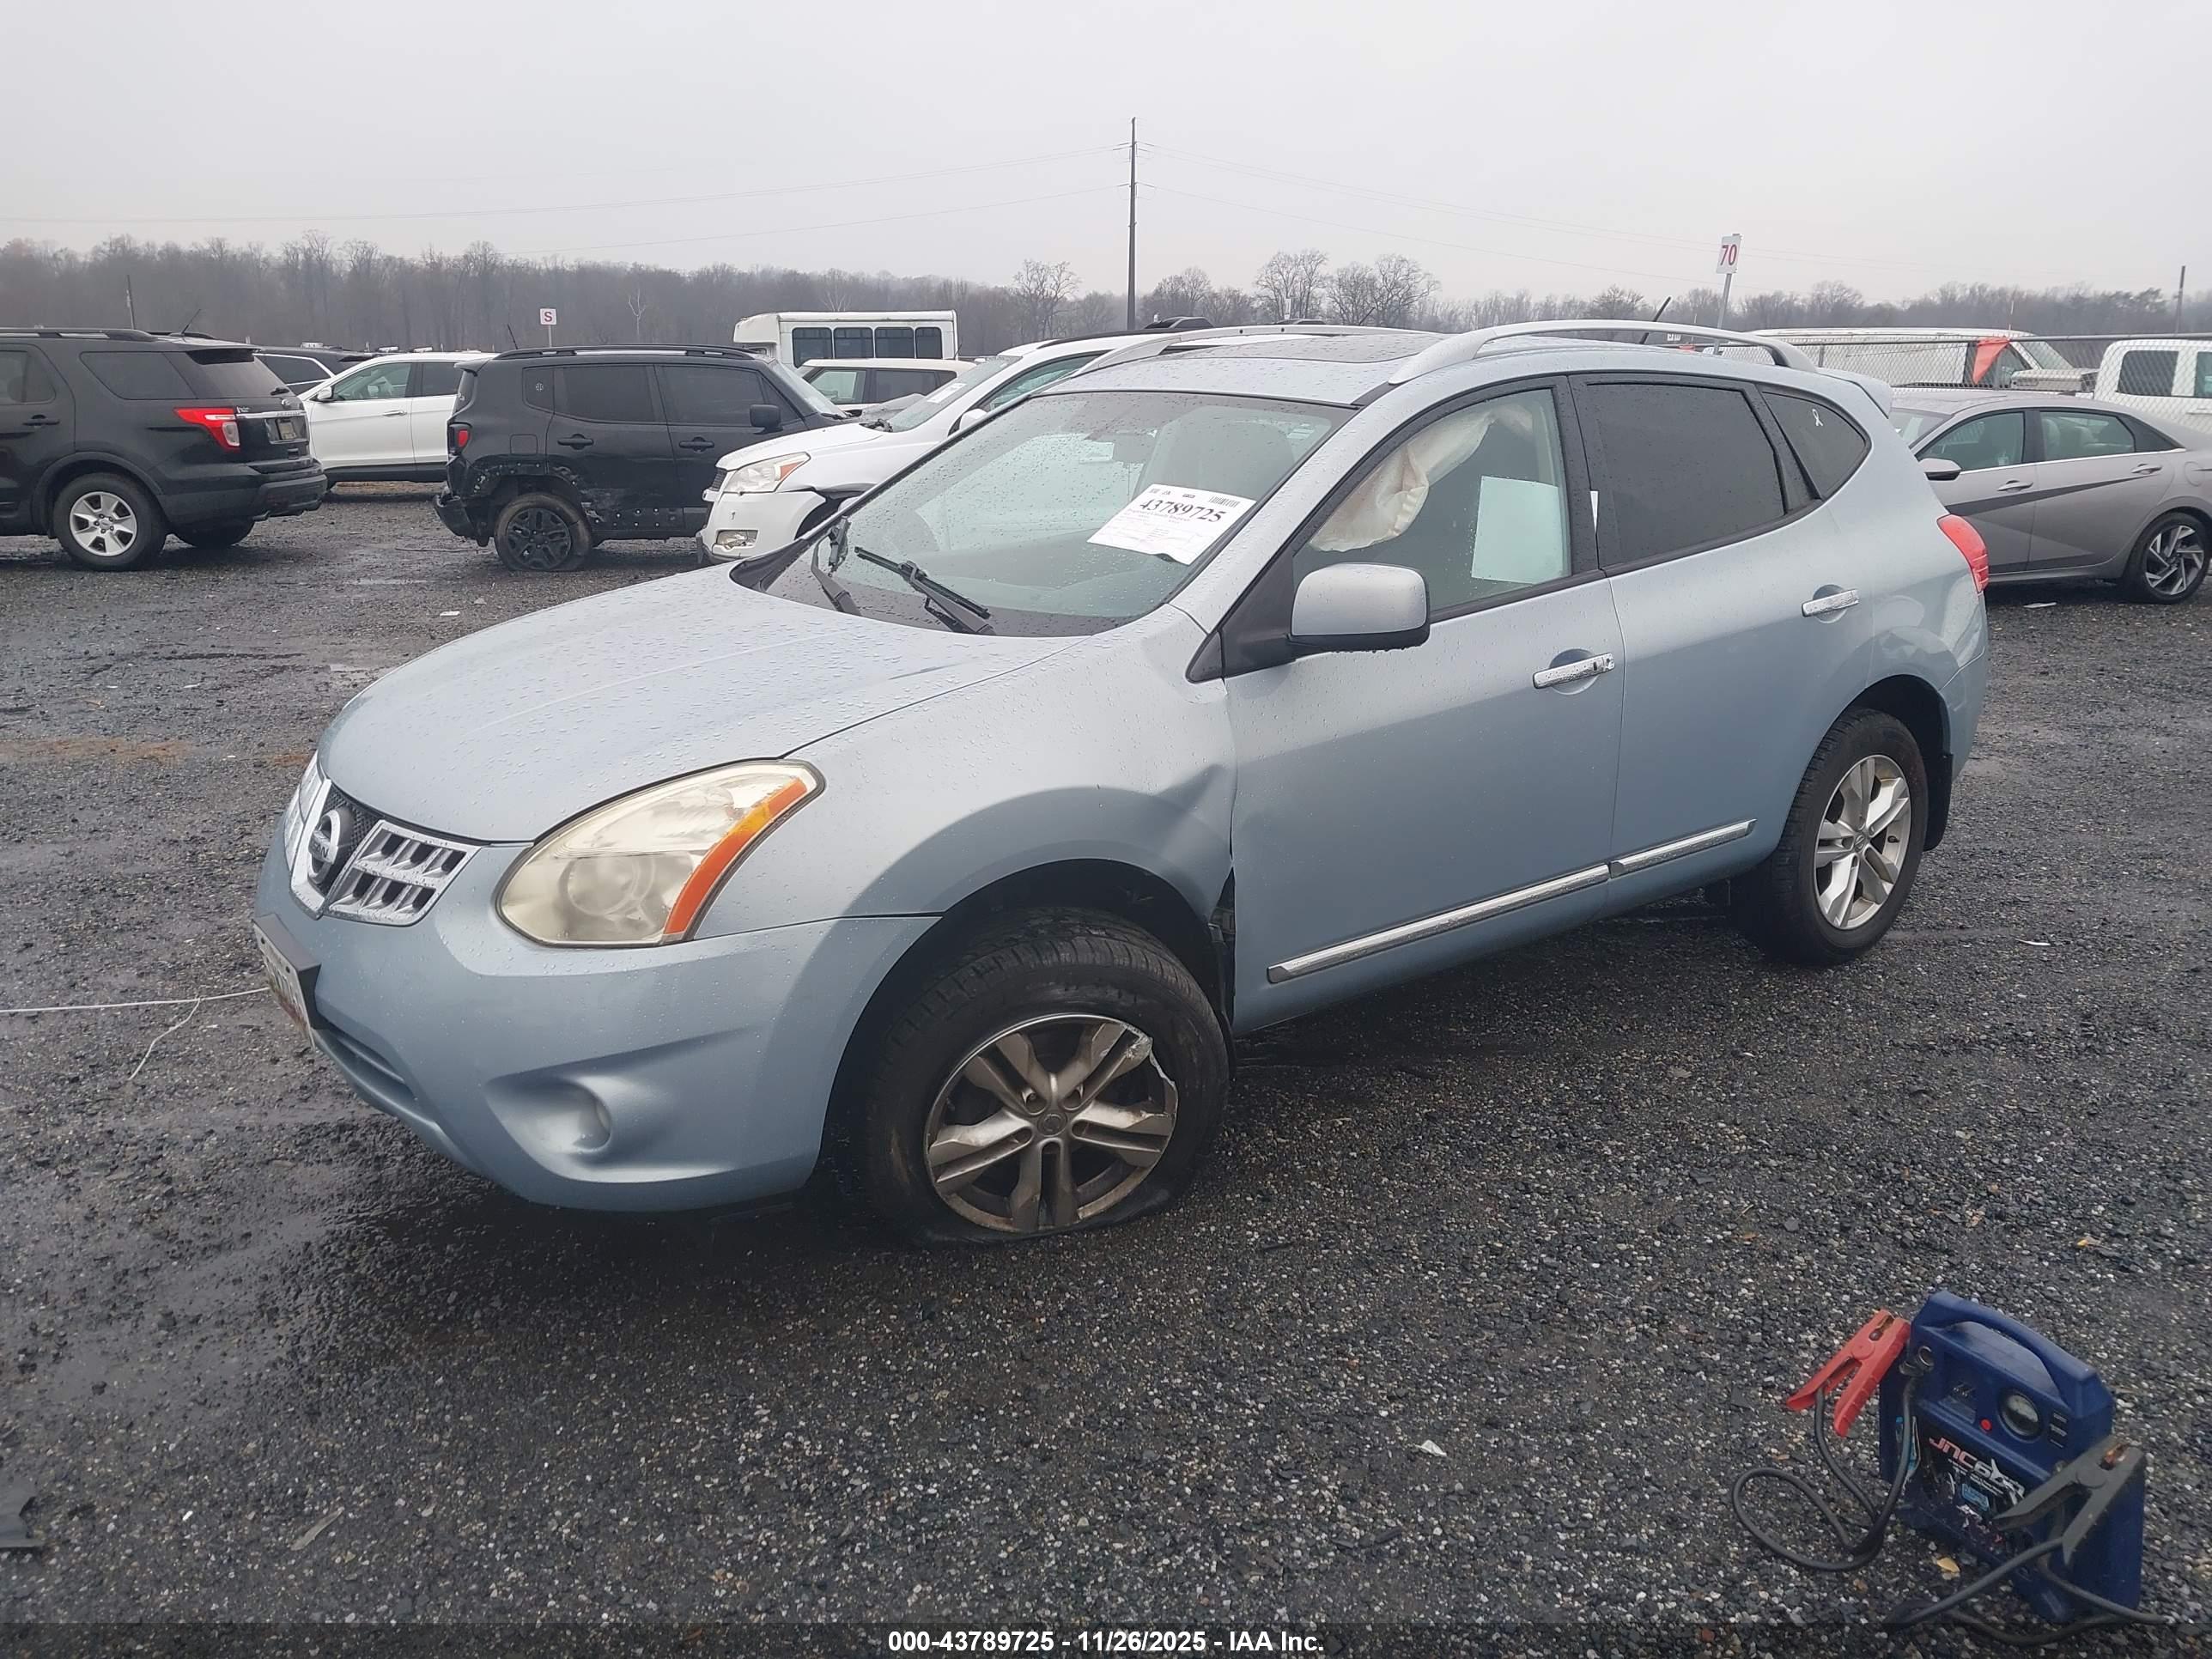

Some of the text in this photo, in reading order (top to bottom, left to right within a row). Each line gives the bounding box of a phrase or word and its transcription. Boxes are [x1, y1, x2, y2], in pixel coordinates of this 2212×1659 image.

[1720, 244, 1738, 266] 70
[544, 311, 553, 323] S
[1139, 499, 1227, 523] 43789725
